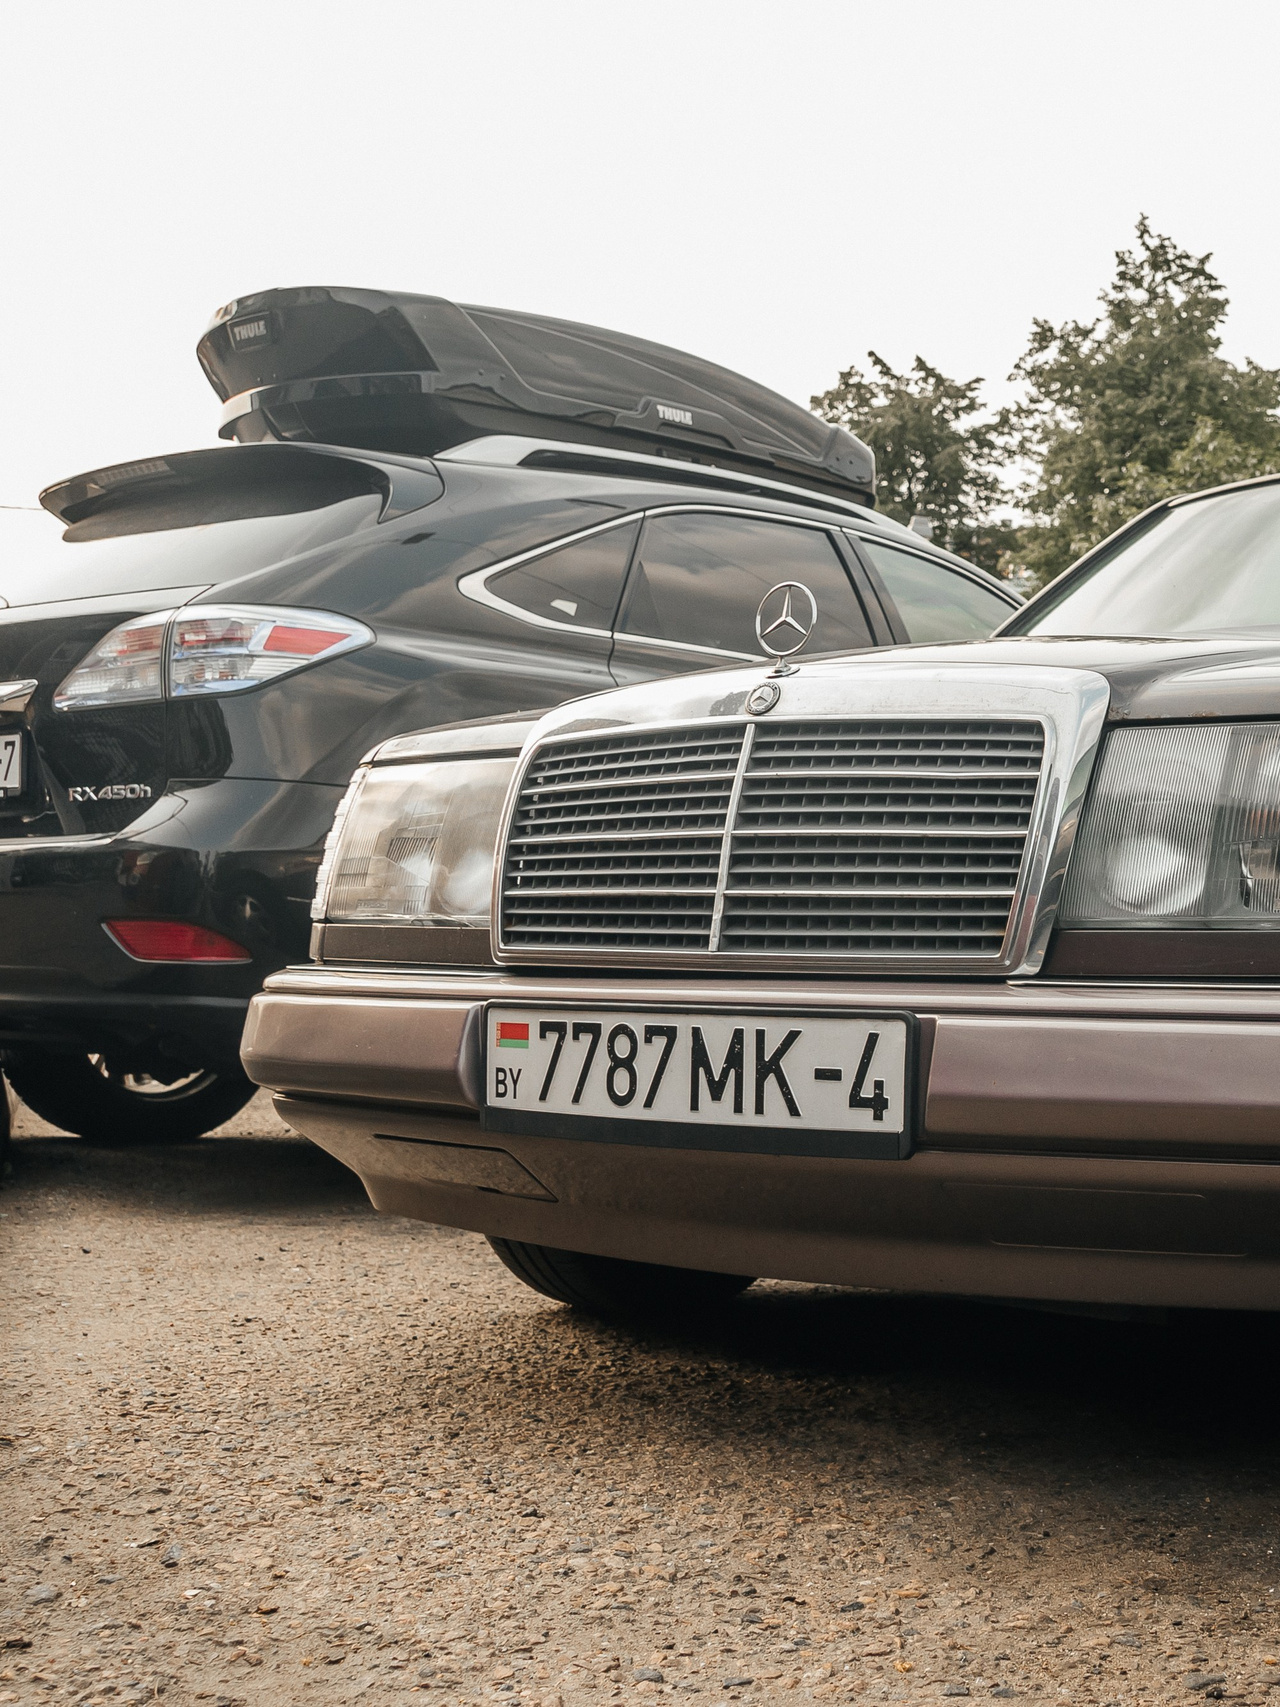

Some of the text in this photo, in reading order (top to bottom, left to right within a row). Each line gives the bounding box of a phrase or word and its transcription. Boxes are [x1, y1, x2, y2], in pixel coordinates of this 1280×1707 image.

[234, 320, 267, 341] THULE
[656, 404, 693, 426] THULE
[494, 1067, 523, 1100] BY
